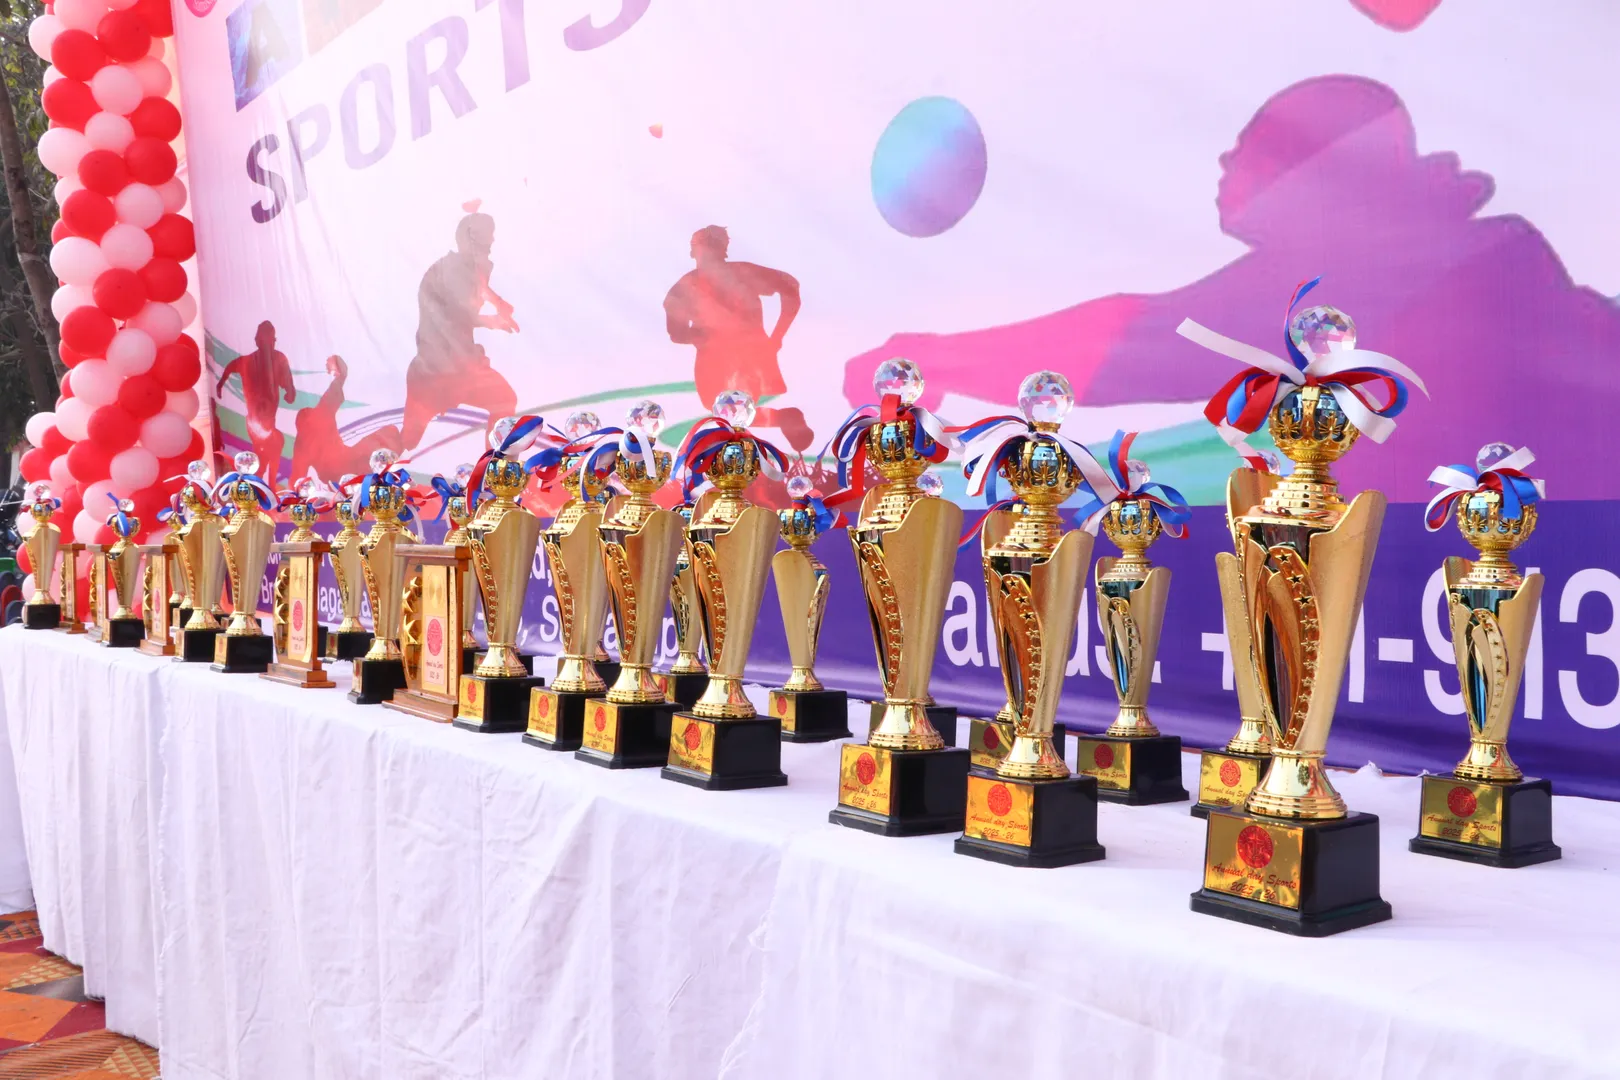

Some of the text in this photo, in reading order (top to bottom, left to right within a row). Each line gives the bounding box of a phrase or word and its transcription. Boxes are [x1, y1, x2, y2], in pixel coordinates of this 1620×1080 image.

[970, 812, 993, 825] Annual
[982, 826, 1000, 838] 2025
[1211, 862, 1297, 890] Annual day Sports
[1230, 881, 1256, 896] 2025
[1263, 888, 1276, 901] 26
